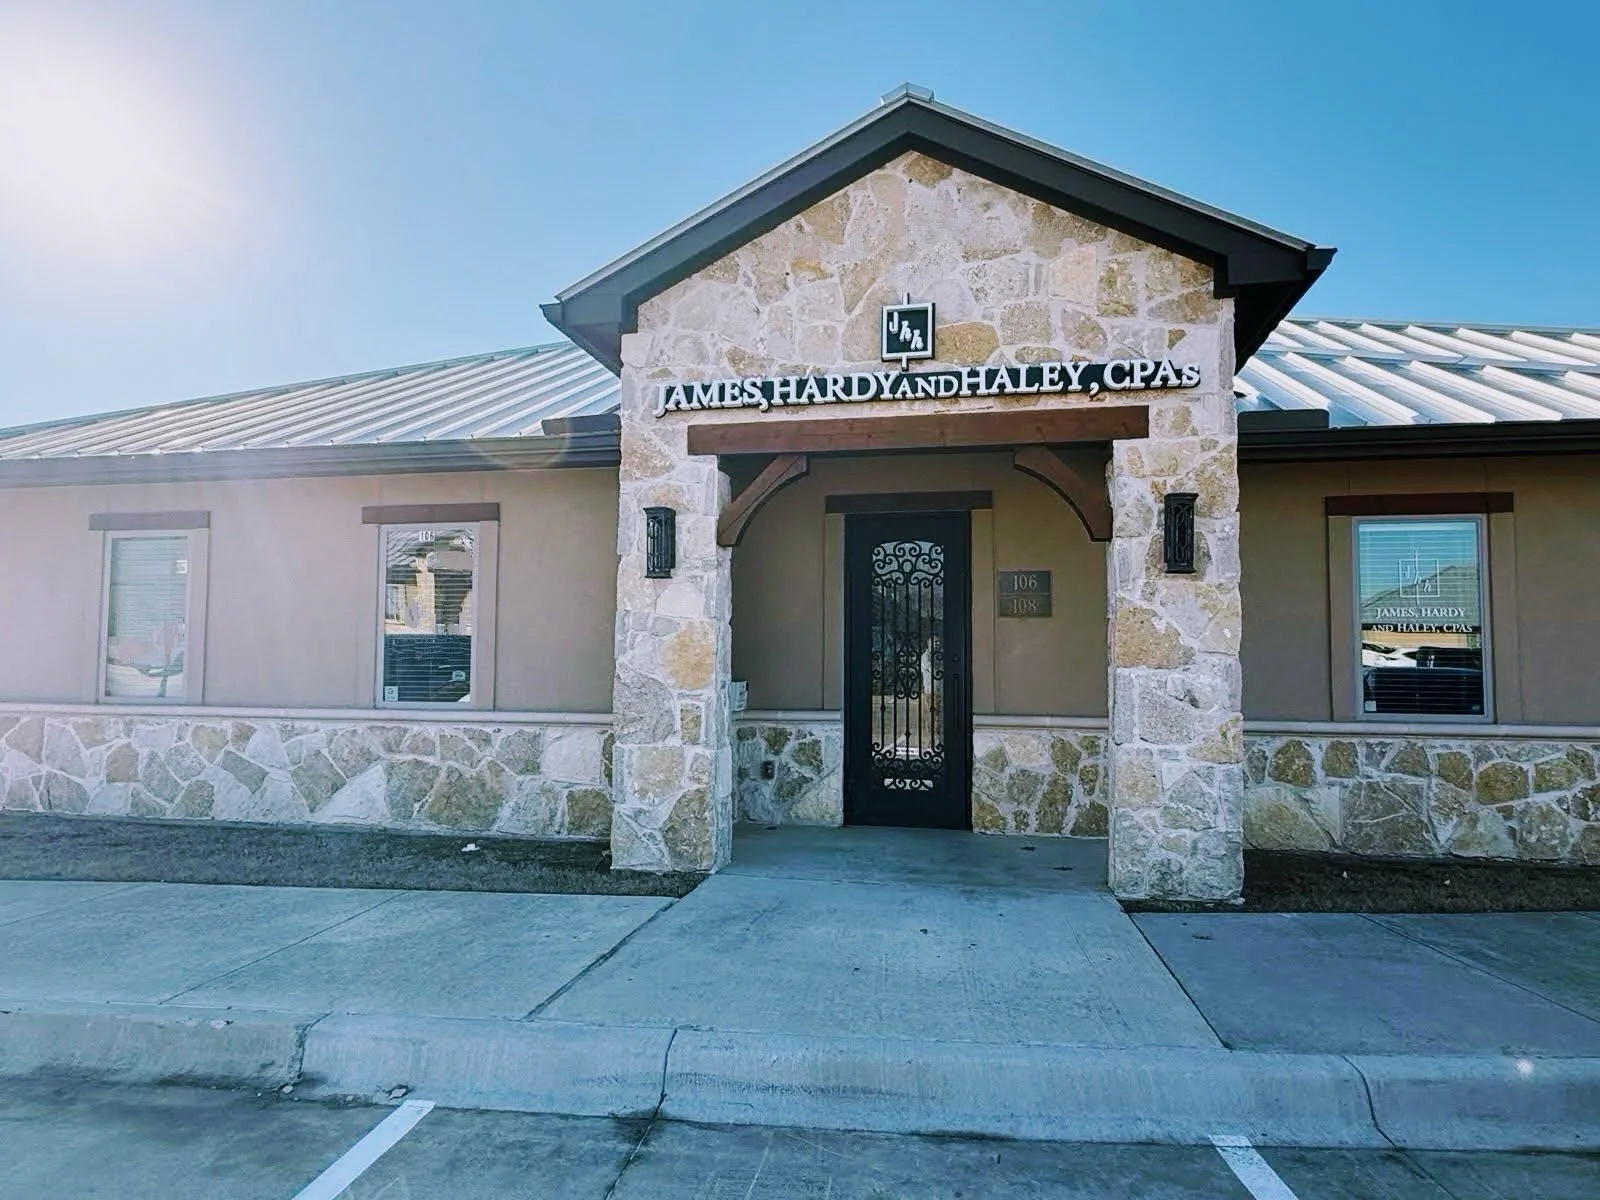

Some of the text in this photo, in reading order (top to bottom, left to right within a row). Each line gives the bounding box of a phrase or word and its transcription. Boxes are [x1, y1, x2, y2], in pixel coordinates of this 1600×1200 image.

[770, 370, 899, 405] HARDY
[896, 374, 959, 400] AND
[957, 361, 1101, 398] HALEY,
[421, 531, 434, 541] 106
[1013, 575, 1037, 590] 106
[1013, 599, 1037, 613] 108
[1376, 607, 1466, 619] JAMES, HARDY
[1397, 623, 1440, 633] HALEY,
